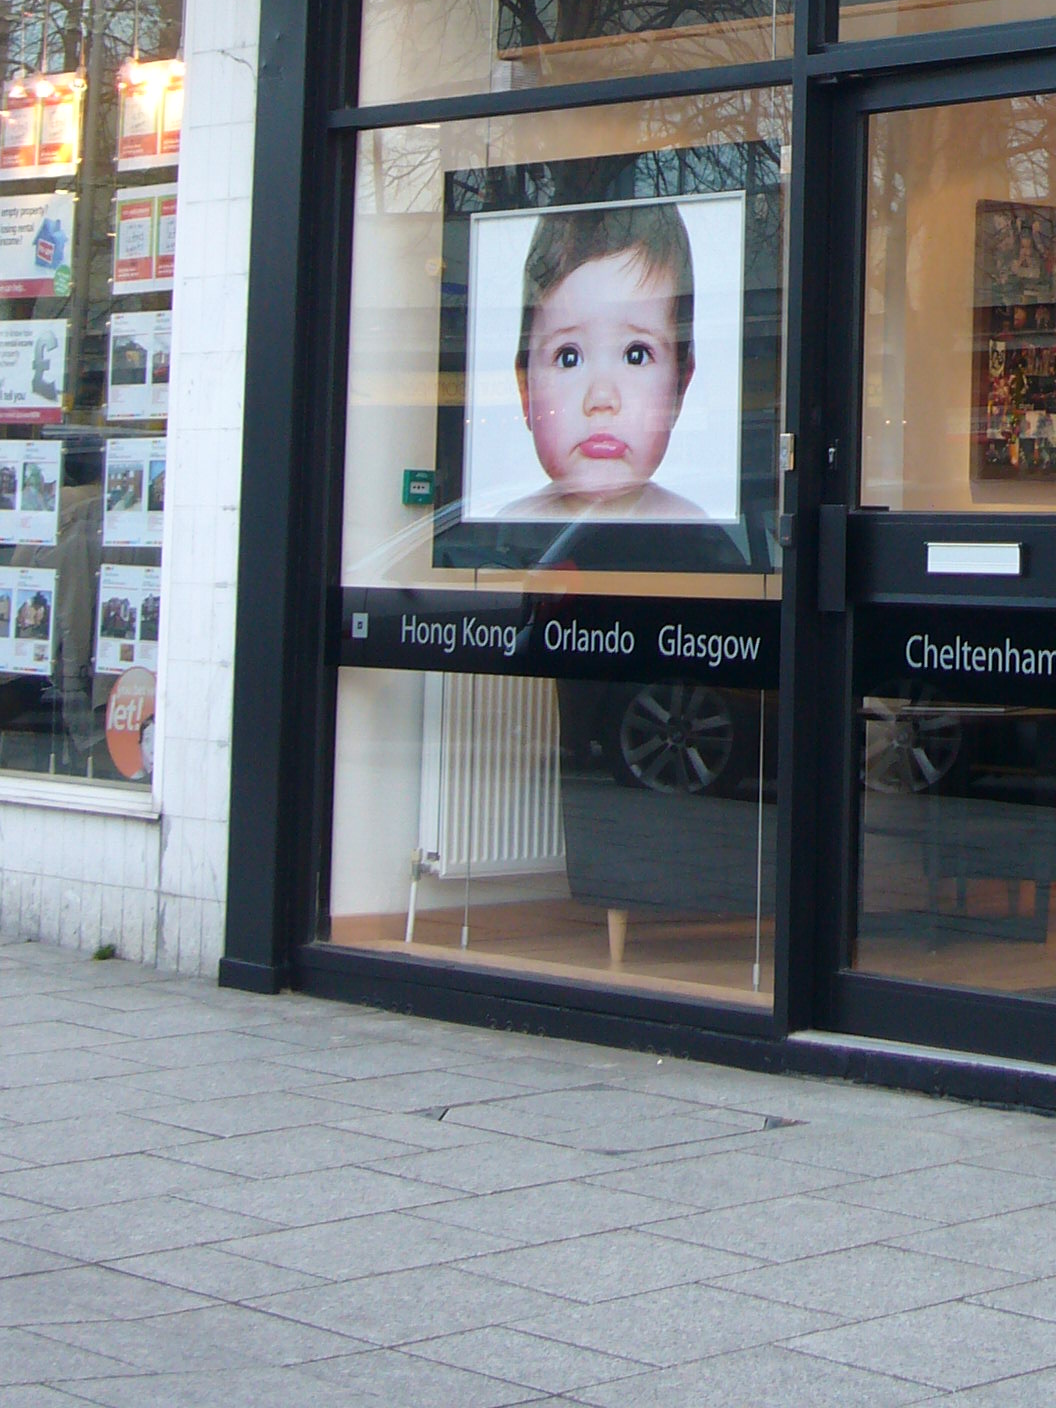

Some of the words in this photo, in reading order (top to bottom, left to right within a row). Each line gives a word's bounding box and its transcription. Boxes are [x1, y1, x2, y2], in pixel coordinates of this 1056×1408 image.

[401, 614, 456, 653] Hong
[462, 617, 517, 656] Kong
[544, 620, 635, 654] Orlando
[658, 625, 761, 667] Glasgow
